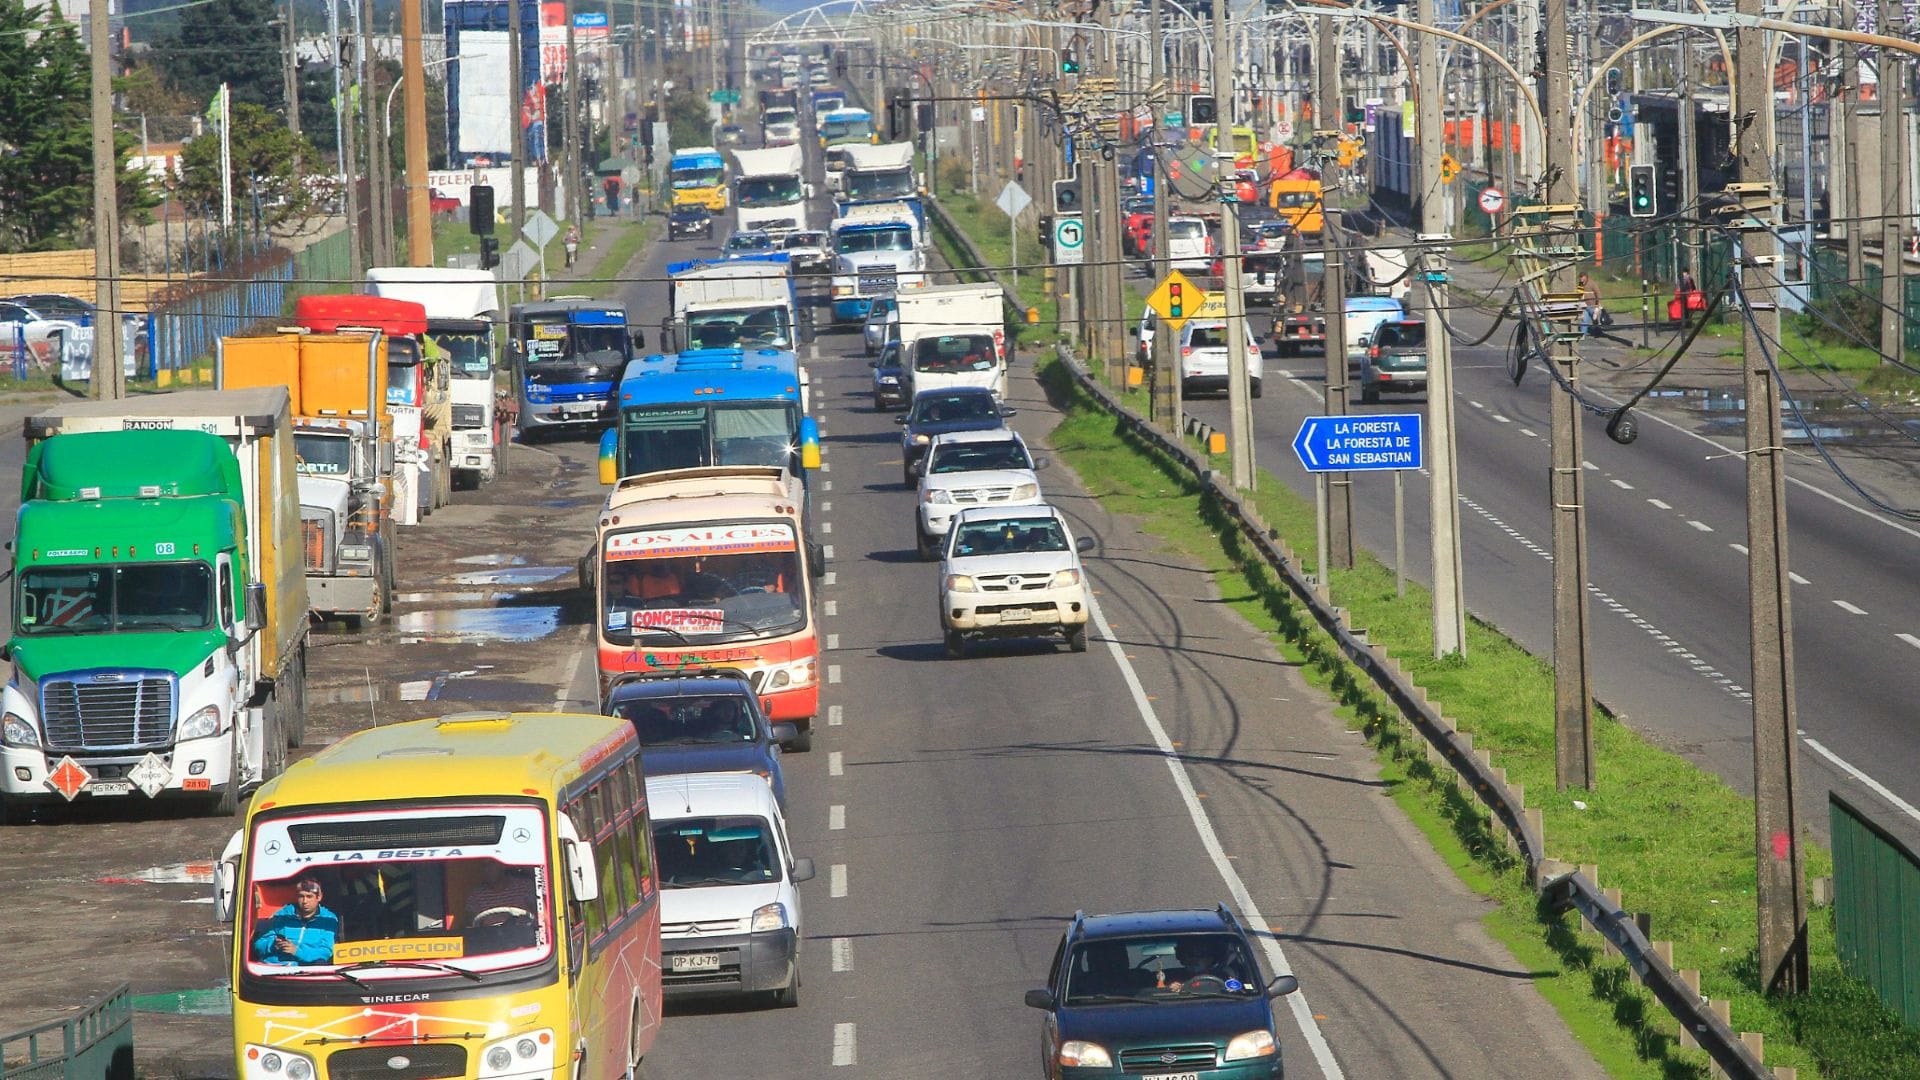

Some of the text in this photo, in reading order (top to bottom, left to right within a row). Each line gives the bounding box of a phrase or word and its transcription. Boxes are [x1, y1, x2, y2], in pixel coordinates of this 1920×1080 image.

[429, 173, 489, 186] TELERA
[125, 421, 172, 430] RANDON
[201, 423, 217, 434] S-01
[1335, 421, 1402, 435] LA FORESTA
[1326, 436, 1411, 450] LA FORESTA DE
[1328, 451, 1412, 465] SAN SEBASTIAN
[613, 528, 788, 547] LOS ALCES
[157, 543, 174, 553] 08
[633, 610, 723, 627] CONCEPCION
[333, 852, 364, 862] LA
[335, 942, 461, 959] CONCEPCION
[370, 992, 430, 1003] INRECAR
